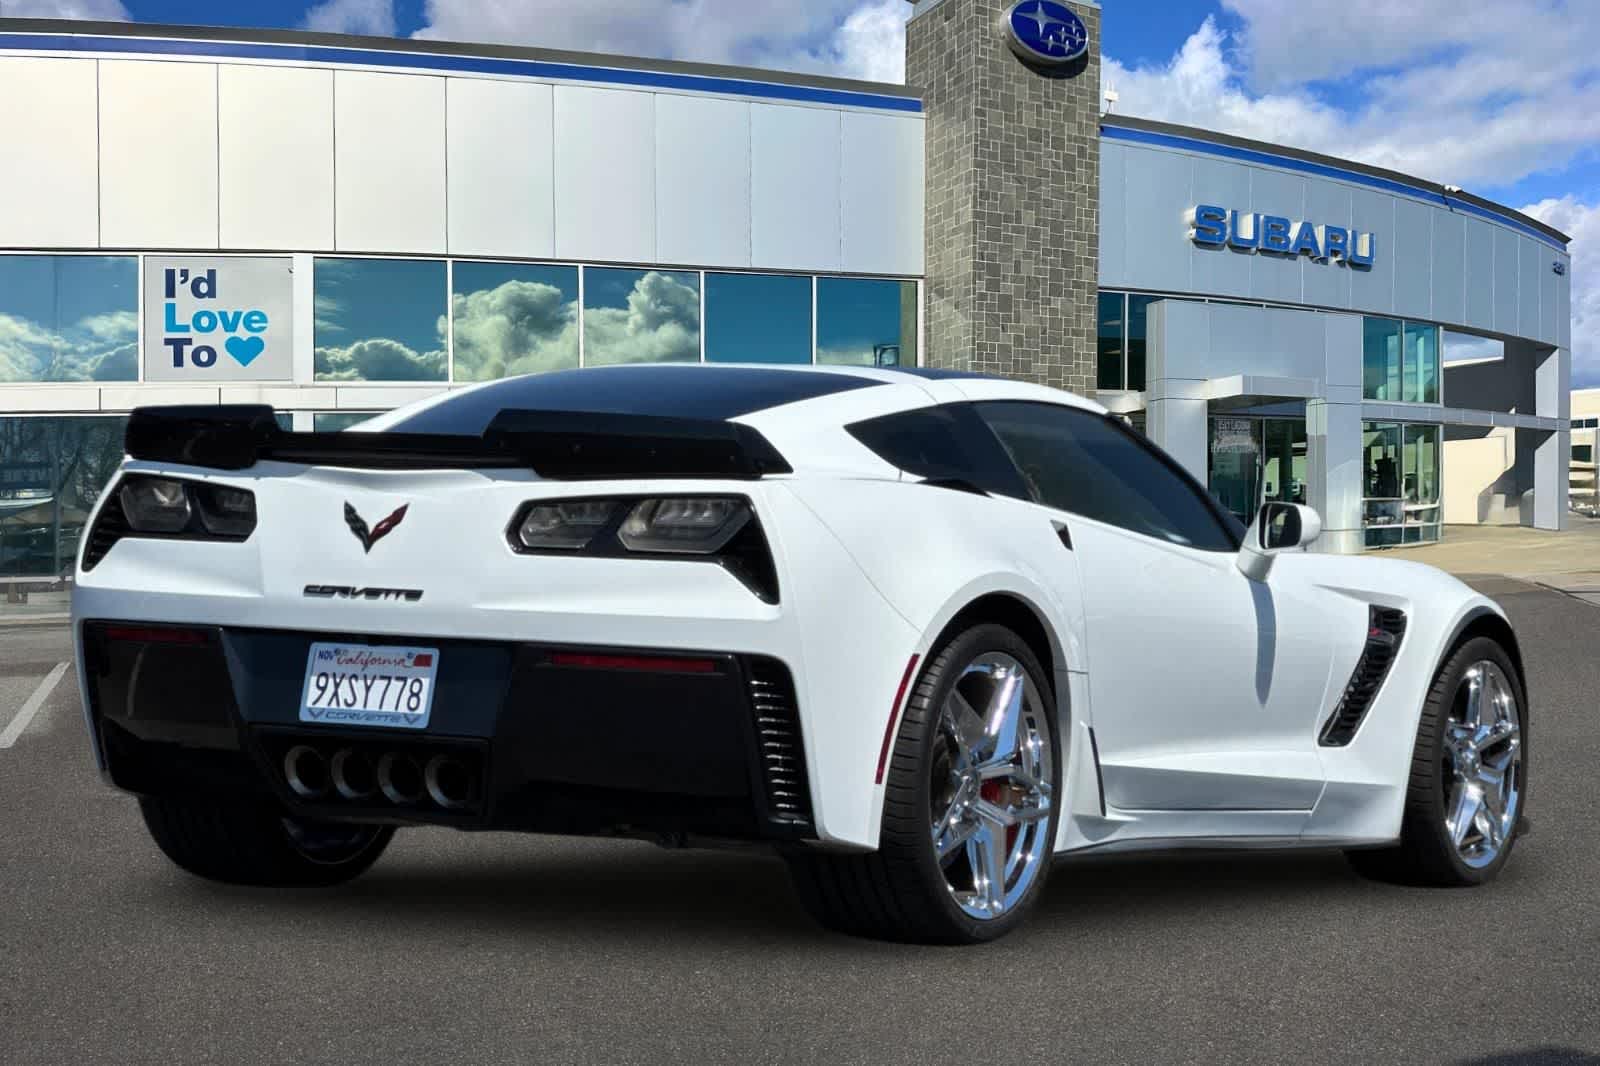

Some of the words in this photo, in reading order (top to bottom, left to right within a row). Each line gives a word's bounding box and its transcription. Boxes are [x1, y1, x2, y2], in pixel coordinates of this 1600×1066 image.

[1190, 204, 1375, 269] SUBARU
[165, 268, 217, 299] I’d
[165, 302, 268, 333] Love
[163, 338, 217, 368] To
[303, 584, 424, 602] CORVETTE
[336, 650, 411, 671] California
[312, 671, 424, 712] 9XSY778
[325, 711, 402, 724] CORVETTE
